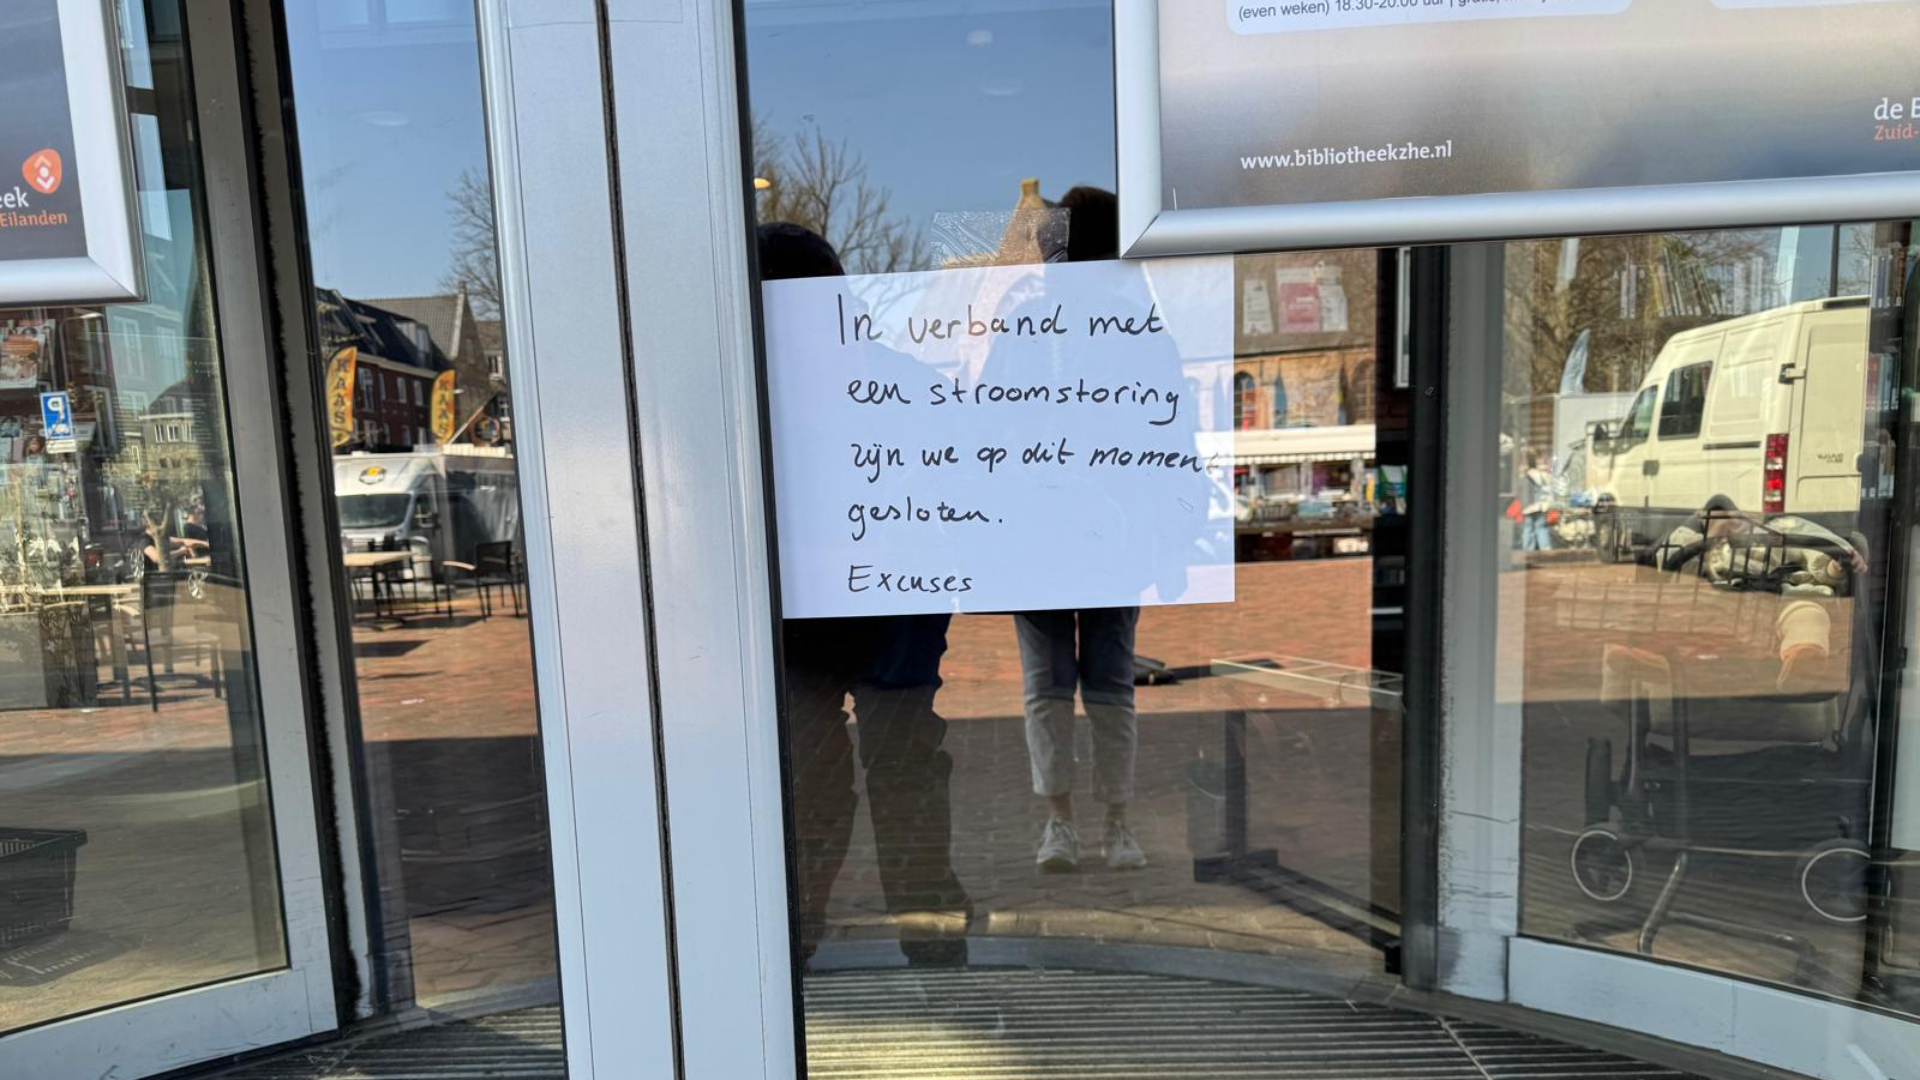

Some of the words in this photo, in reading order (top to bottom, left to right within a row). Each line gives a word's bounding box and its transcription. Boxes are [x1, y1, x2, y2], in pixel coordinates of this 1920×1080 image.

[1238, 5, 1277, 22] (even
[1280, 1, 1330, 17] weken)
[1874, 97, 1903, 120] de
[1874, 123, 1919, 141] Zuid-
[1240, 140, 1452, 169] www.bibliotheekzhe.nl
[0, 186, 29, 208] ek
[0, 210, 68, 227] Eilanden
[838, 293, 883, 345] In
[908, 303, 1068, 344] verband
[1089, 302, 1163, 337] met
[847, 379, 911, 405] een
[930, 377, 1179, 426] stroomstoring
[851, 443, 905, 483] zijn
[922, 446, 960, 466] we
[976, 446, 1008, 473] op
[1022, 437, 1074, 464] dit
[848, 496, 1003, 541] gesloten.
[848, 565, 973, 593] Excuses
